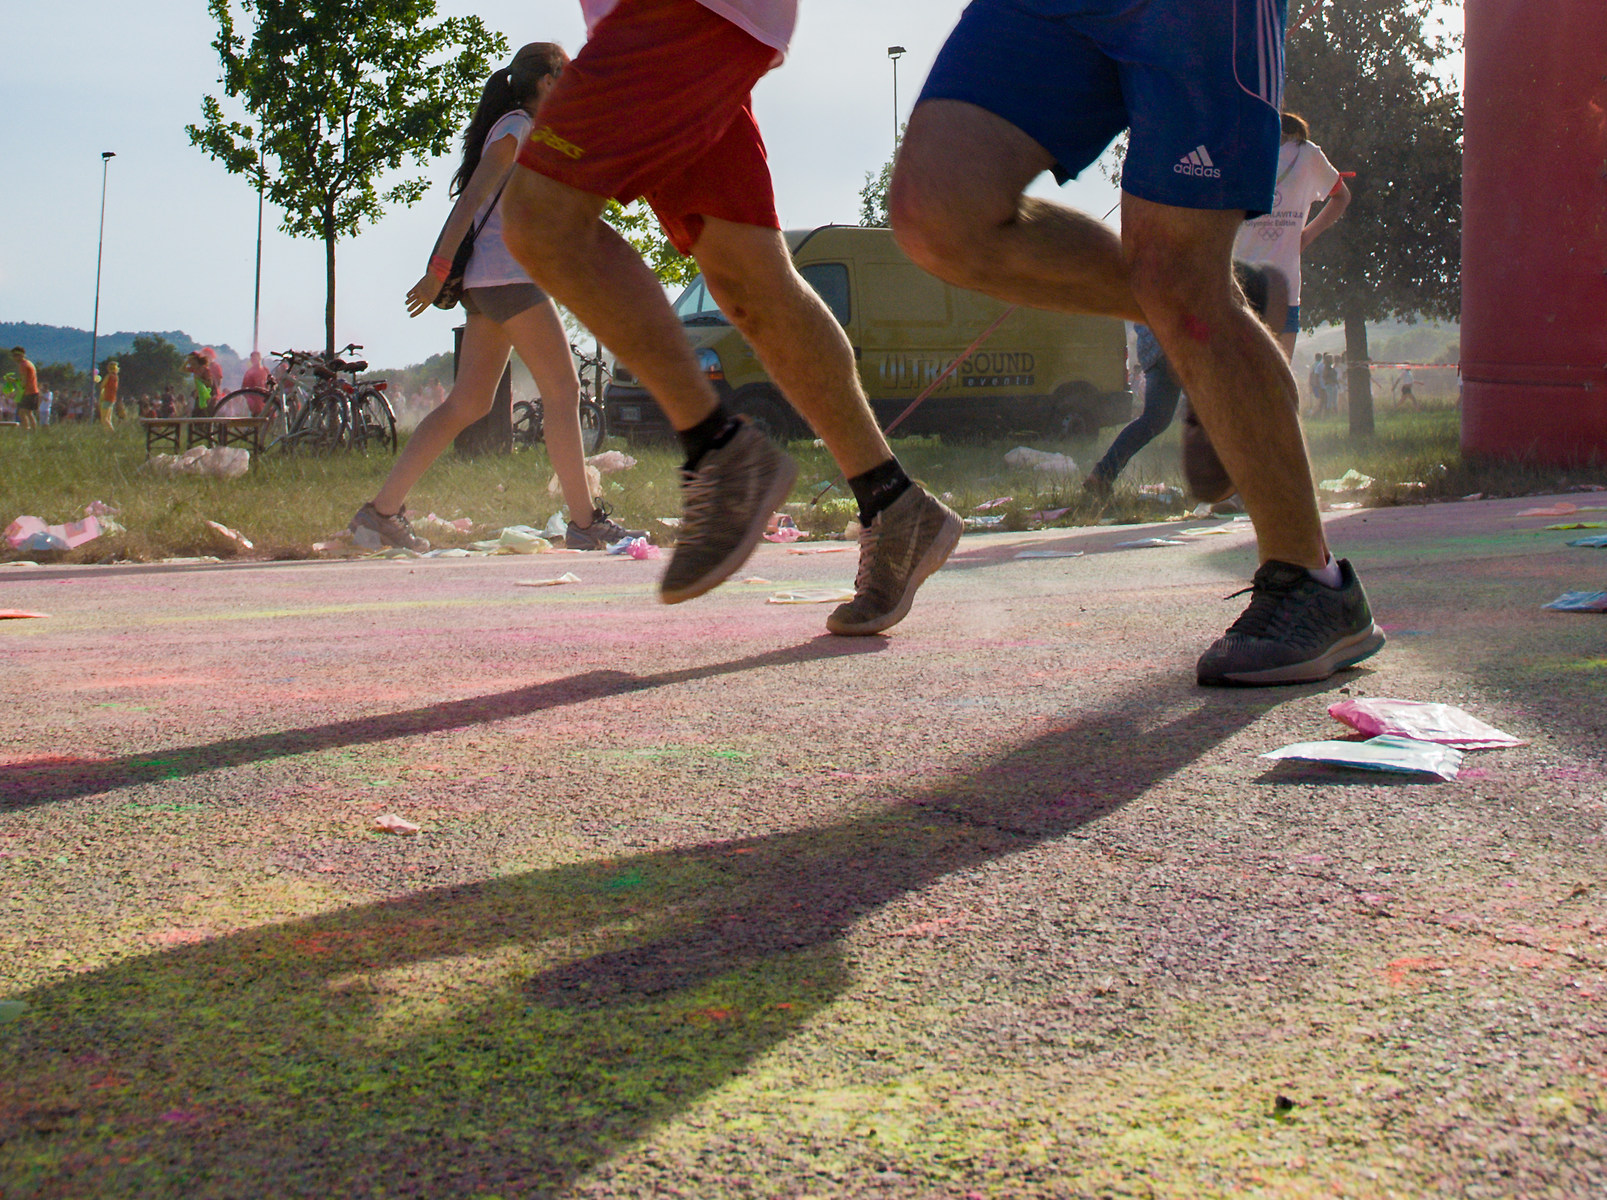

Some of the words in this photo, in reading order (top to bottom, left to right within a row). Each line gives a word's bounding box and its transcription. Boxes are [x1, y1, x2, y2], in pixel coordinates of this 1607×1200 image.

[1173, 163, 1221, 178] adidas
[960, 352, 1036, 374] SOUND
[966, 376, 1031, 388] eventi
